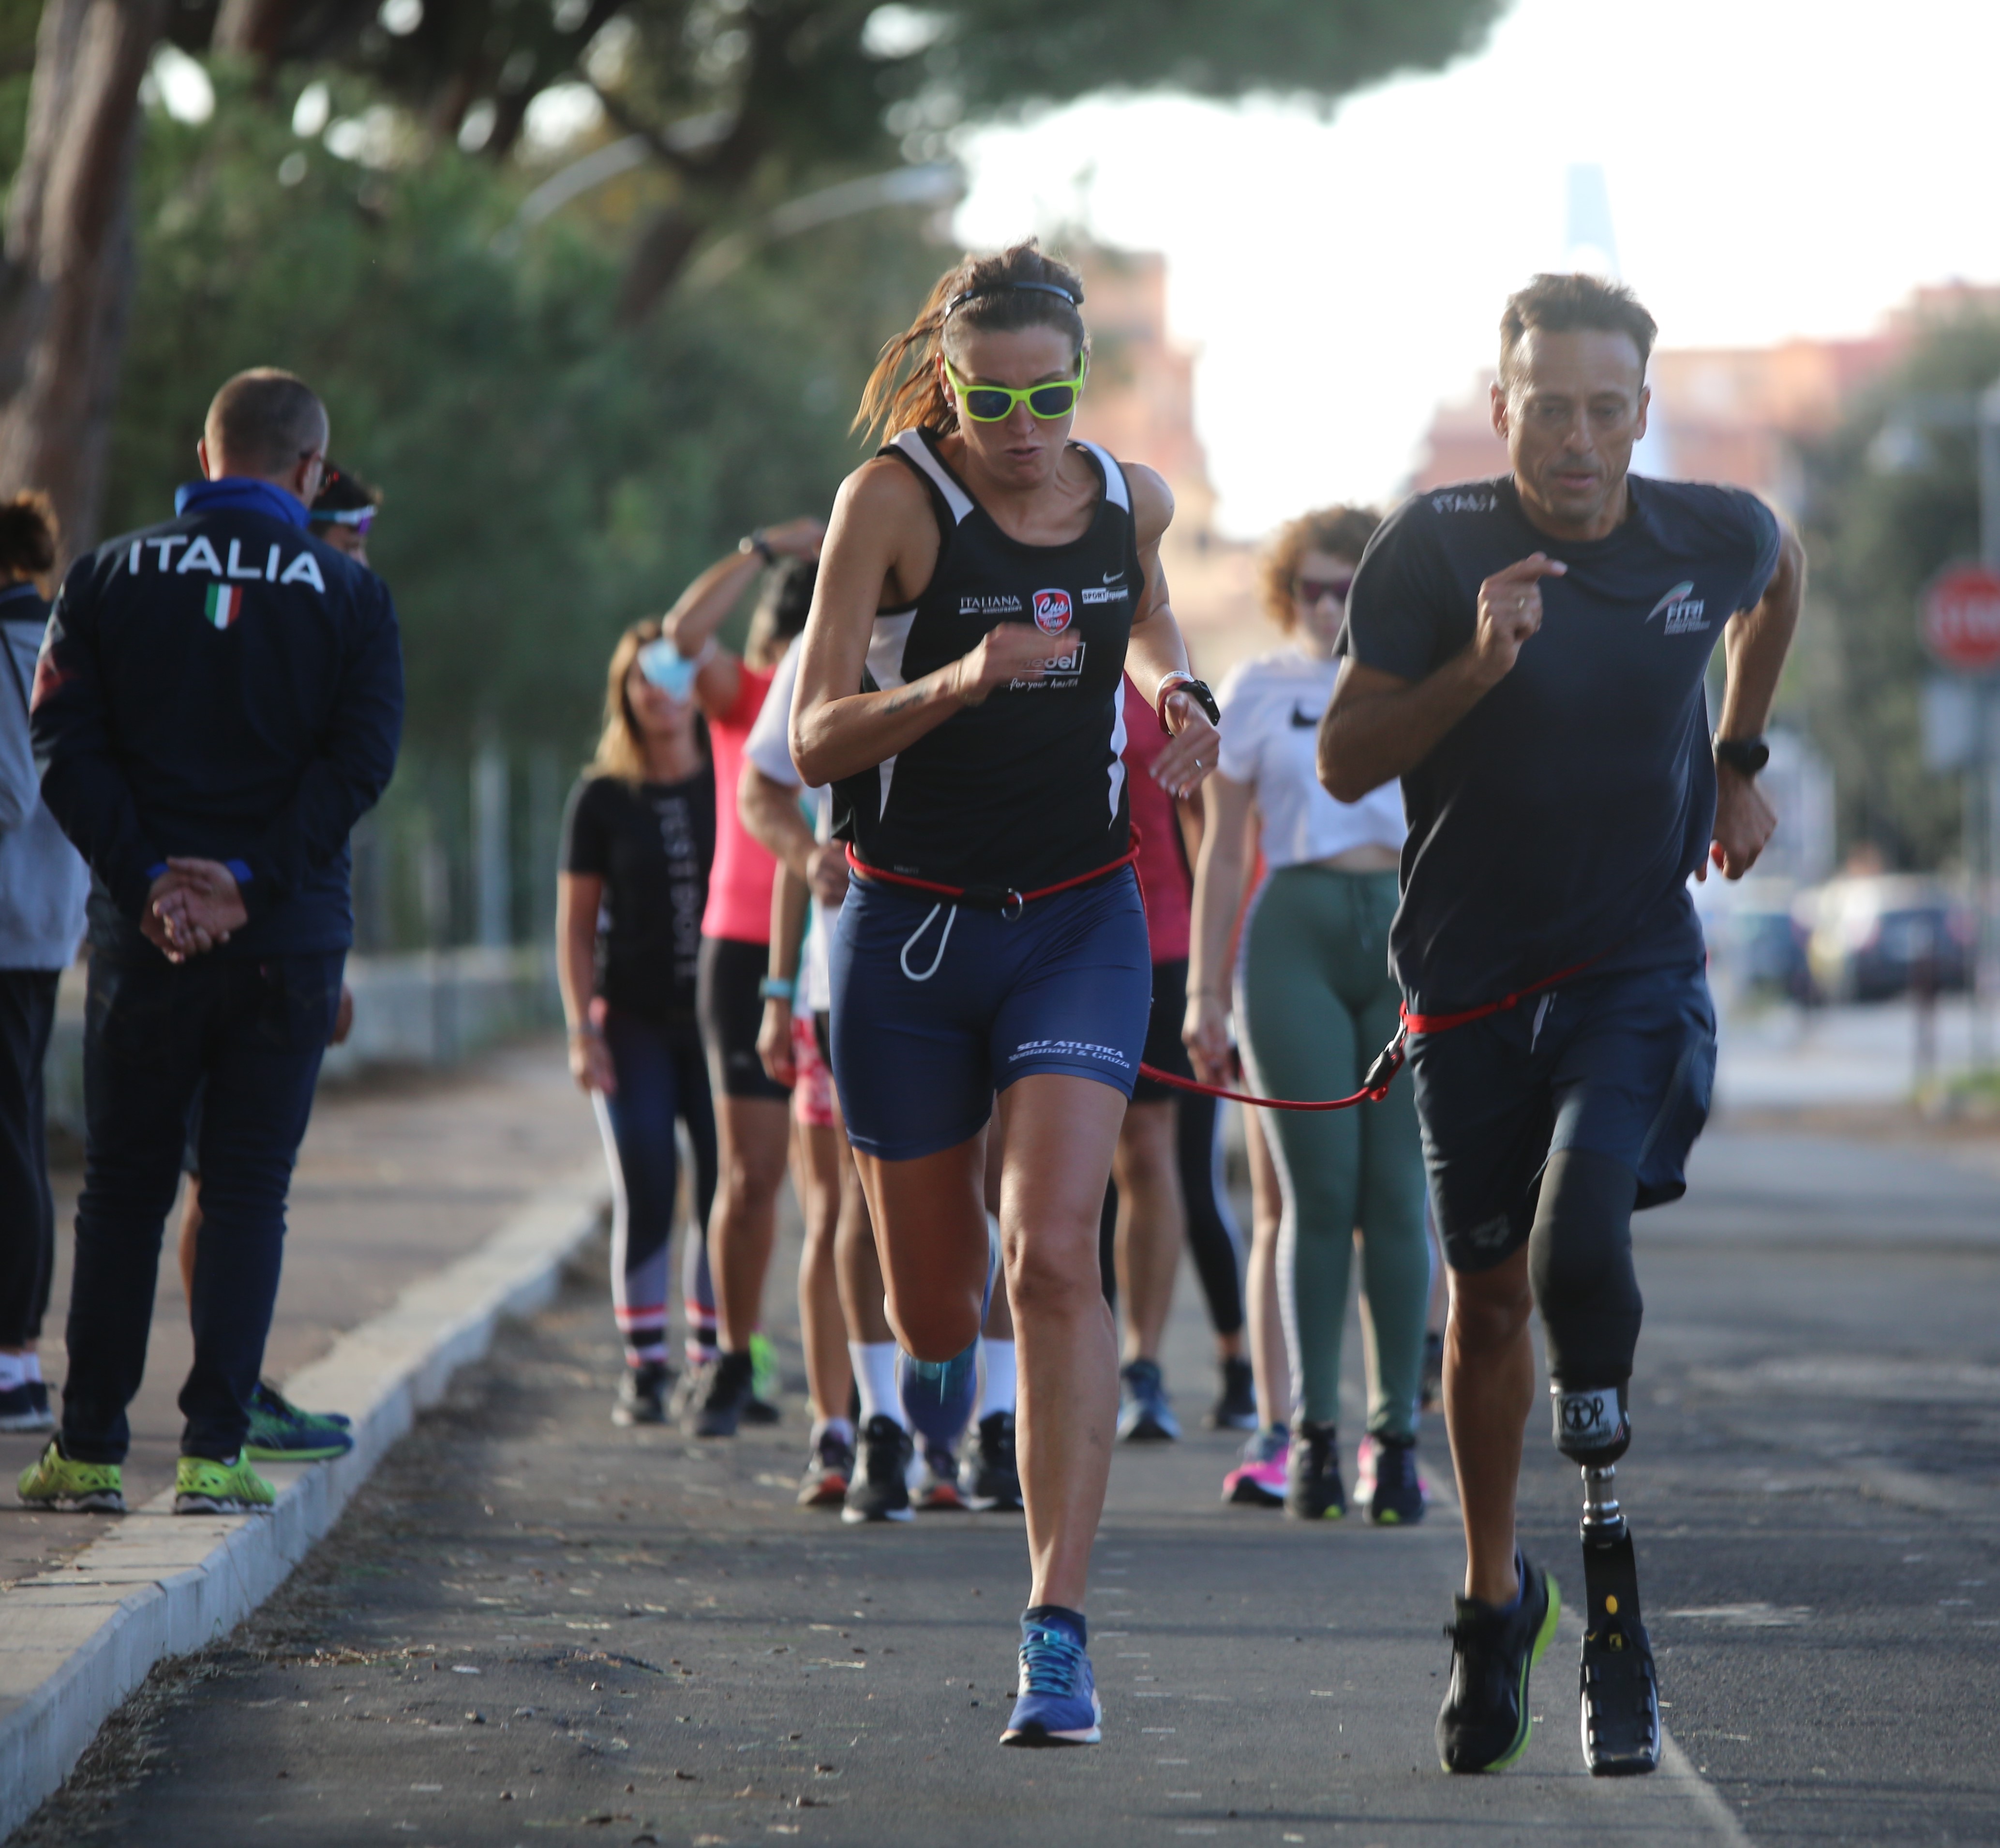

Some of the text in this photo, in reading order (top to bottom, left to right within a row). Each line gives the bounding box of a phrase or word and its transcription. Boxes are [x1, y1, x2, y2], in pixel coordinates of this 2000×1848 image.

[129, 535, 326, 594] ITALIA
[960, 595, 1021, 608] ITALIANA
[1017, 1040, 1124, 1058] SELF ATLETICA
